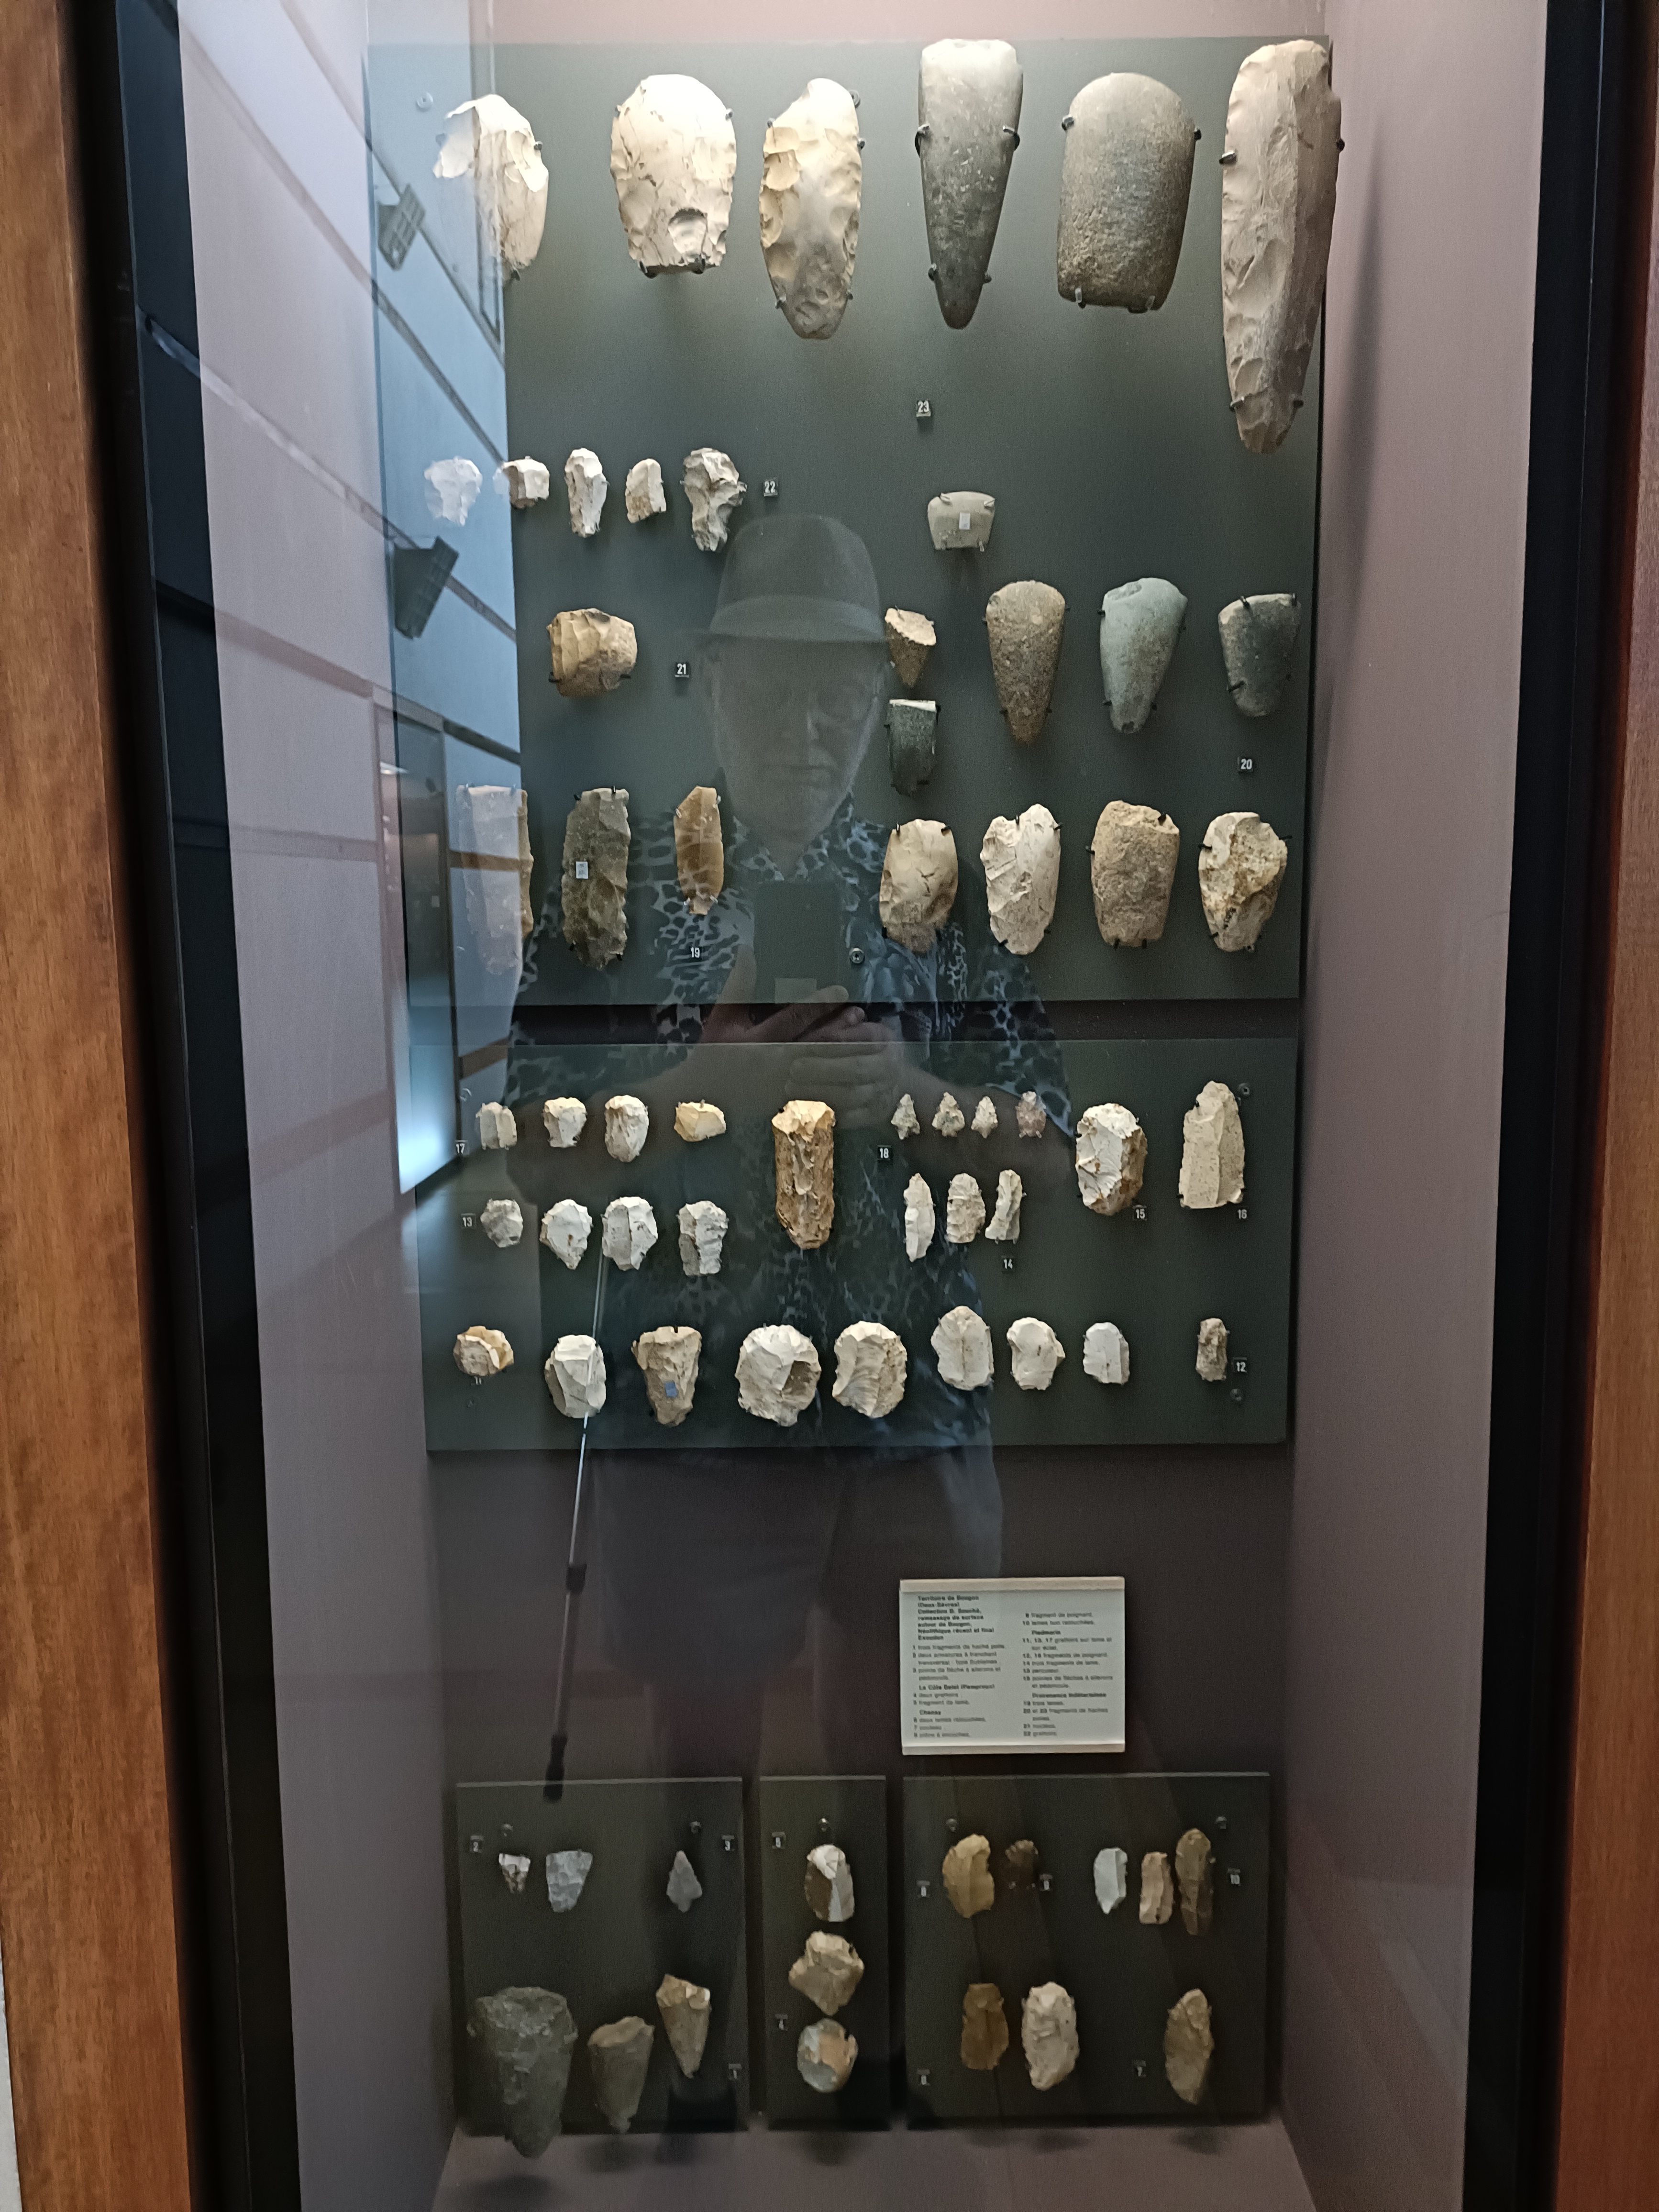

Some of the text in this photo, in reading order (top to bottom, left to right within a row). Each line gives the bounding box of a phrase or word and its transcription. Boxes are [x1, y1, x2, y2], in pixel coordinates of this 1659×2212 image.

[918, 401, 929, 412] 23
[764, 481, 775, 493] 22
[677, 663, 686, 675] 21
[1241, 759, 1252, 770] 20
[690, 947, 700, 958] 19
[456, 1143, 465, 1153] 17
[879, 1148, 889, 1158] 18
[1136, 1209, 1145, 1219] 15
[1237, 1209, 1247, 1219] 16
[1004, 1259, 1013, 1269] 14
[1236, 1361, 1246, 1372] 12
